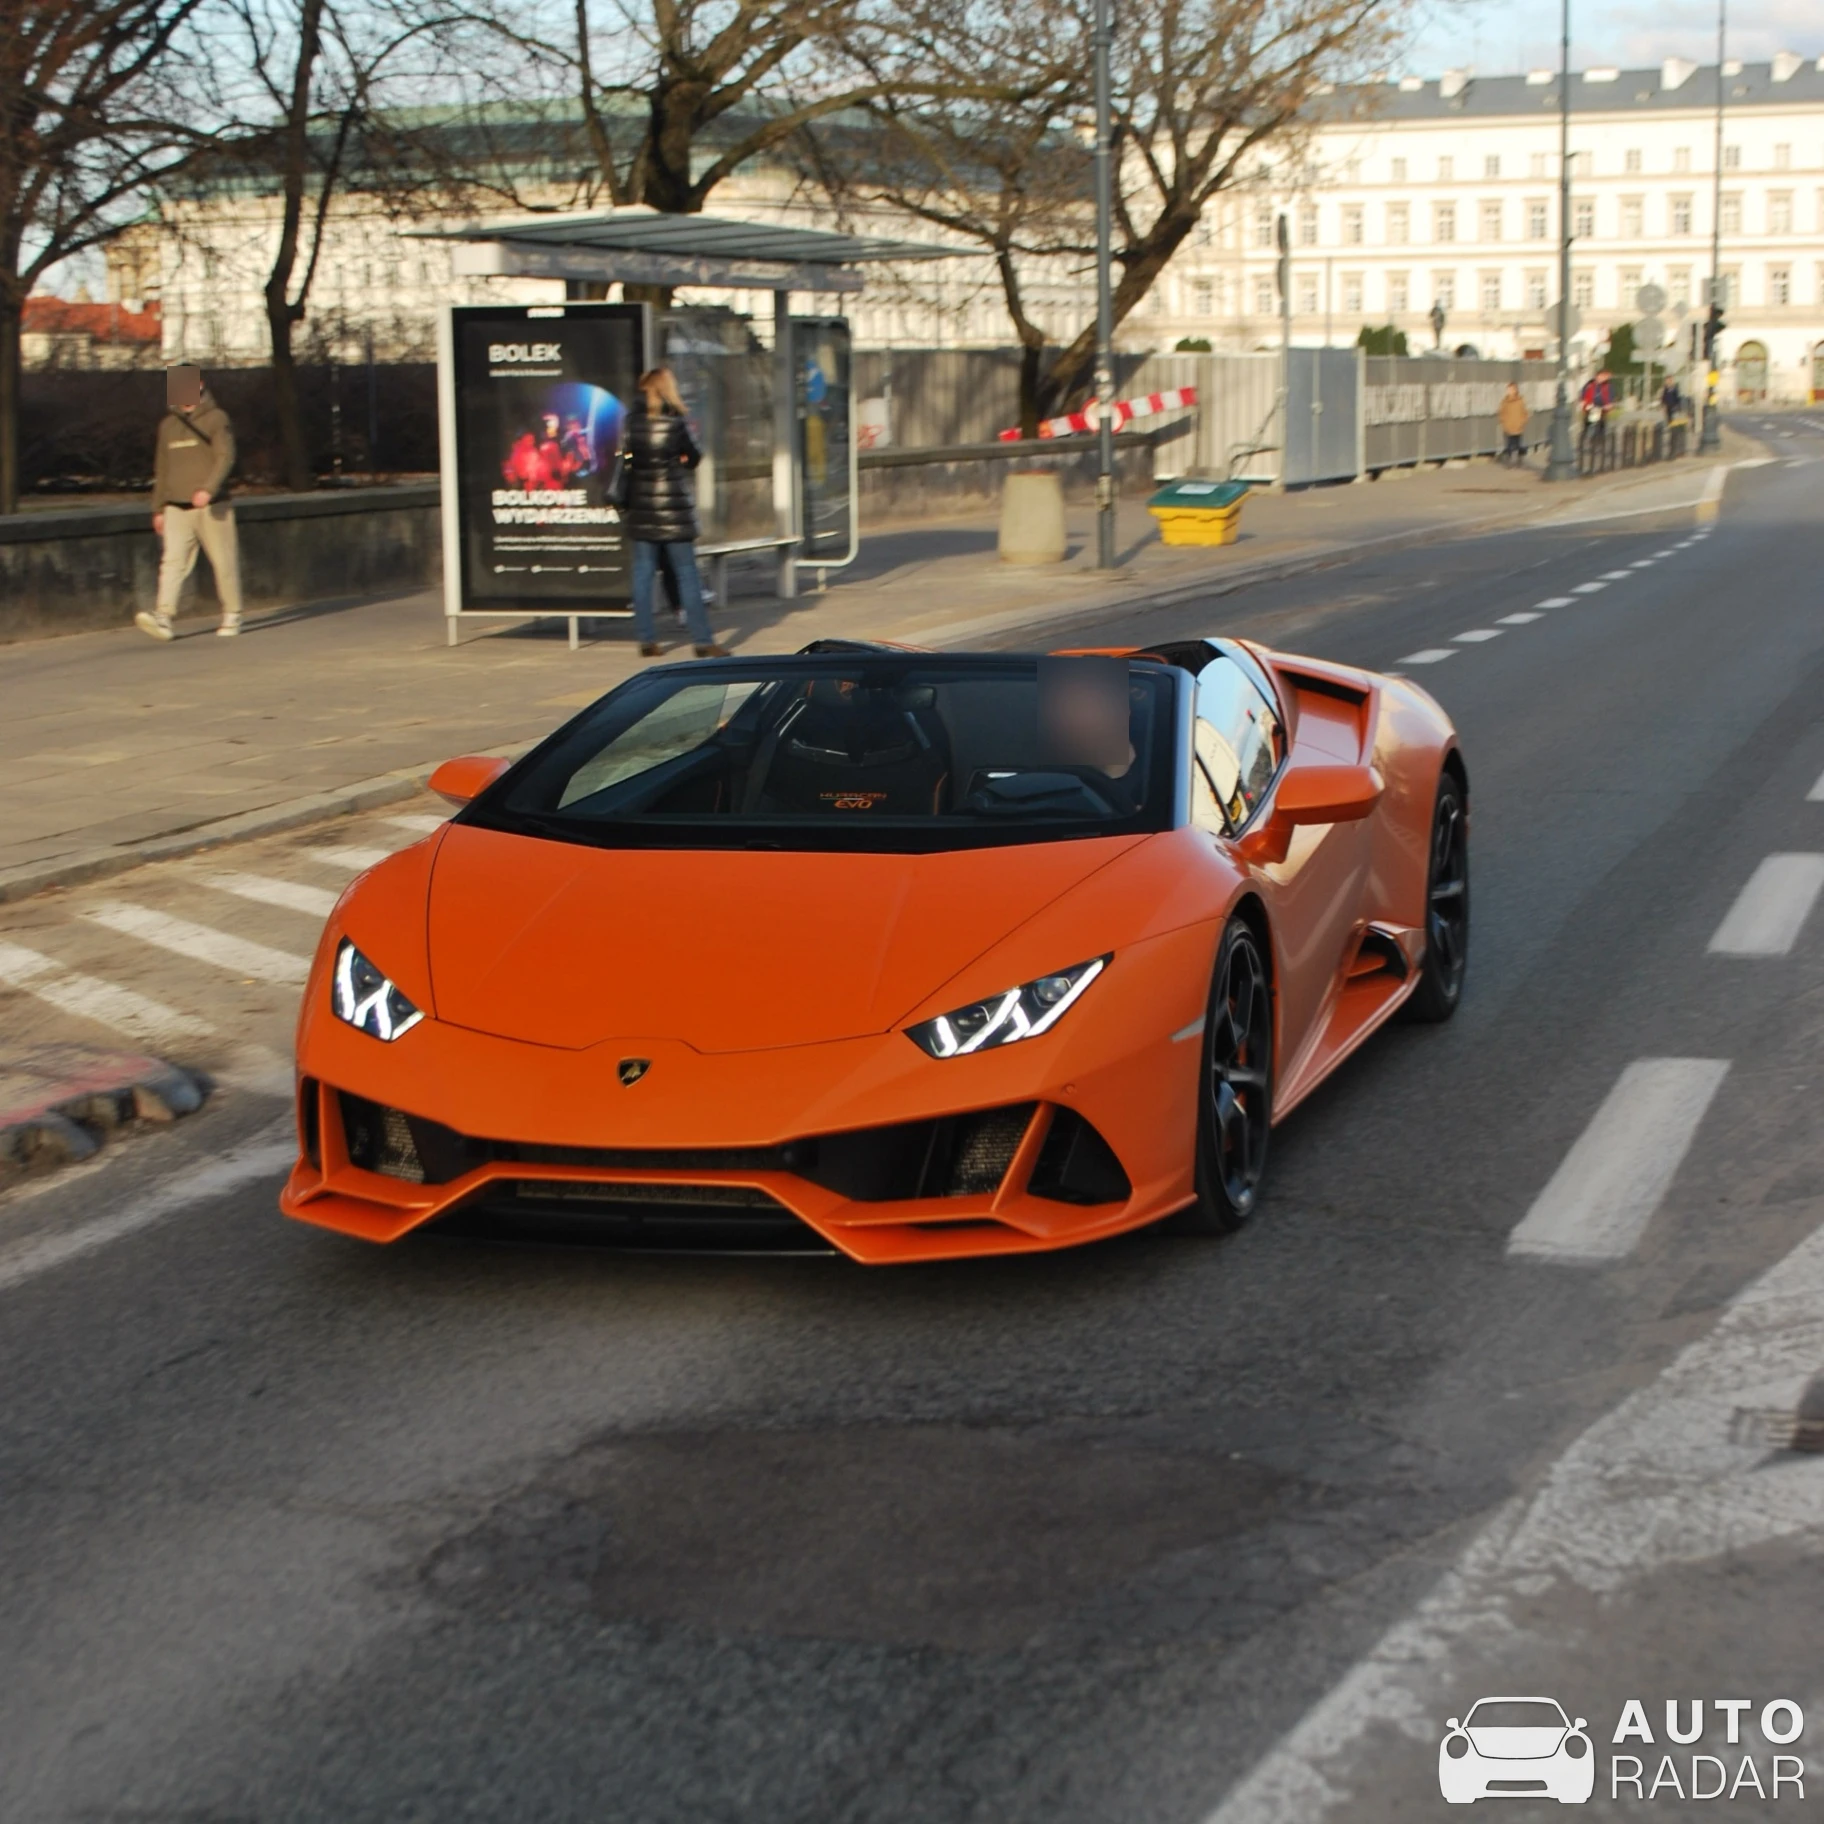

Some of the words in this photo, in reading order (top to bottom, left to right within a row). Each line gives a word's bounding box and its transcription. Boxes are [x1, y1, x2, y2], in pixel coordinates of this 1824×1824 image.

[488, 343, 562, 362] BOLEK
[492, 507, 621, 524] WYDARZENIA
[834, 800, 873, 809] EVO
